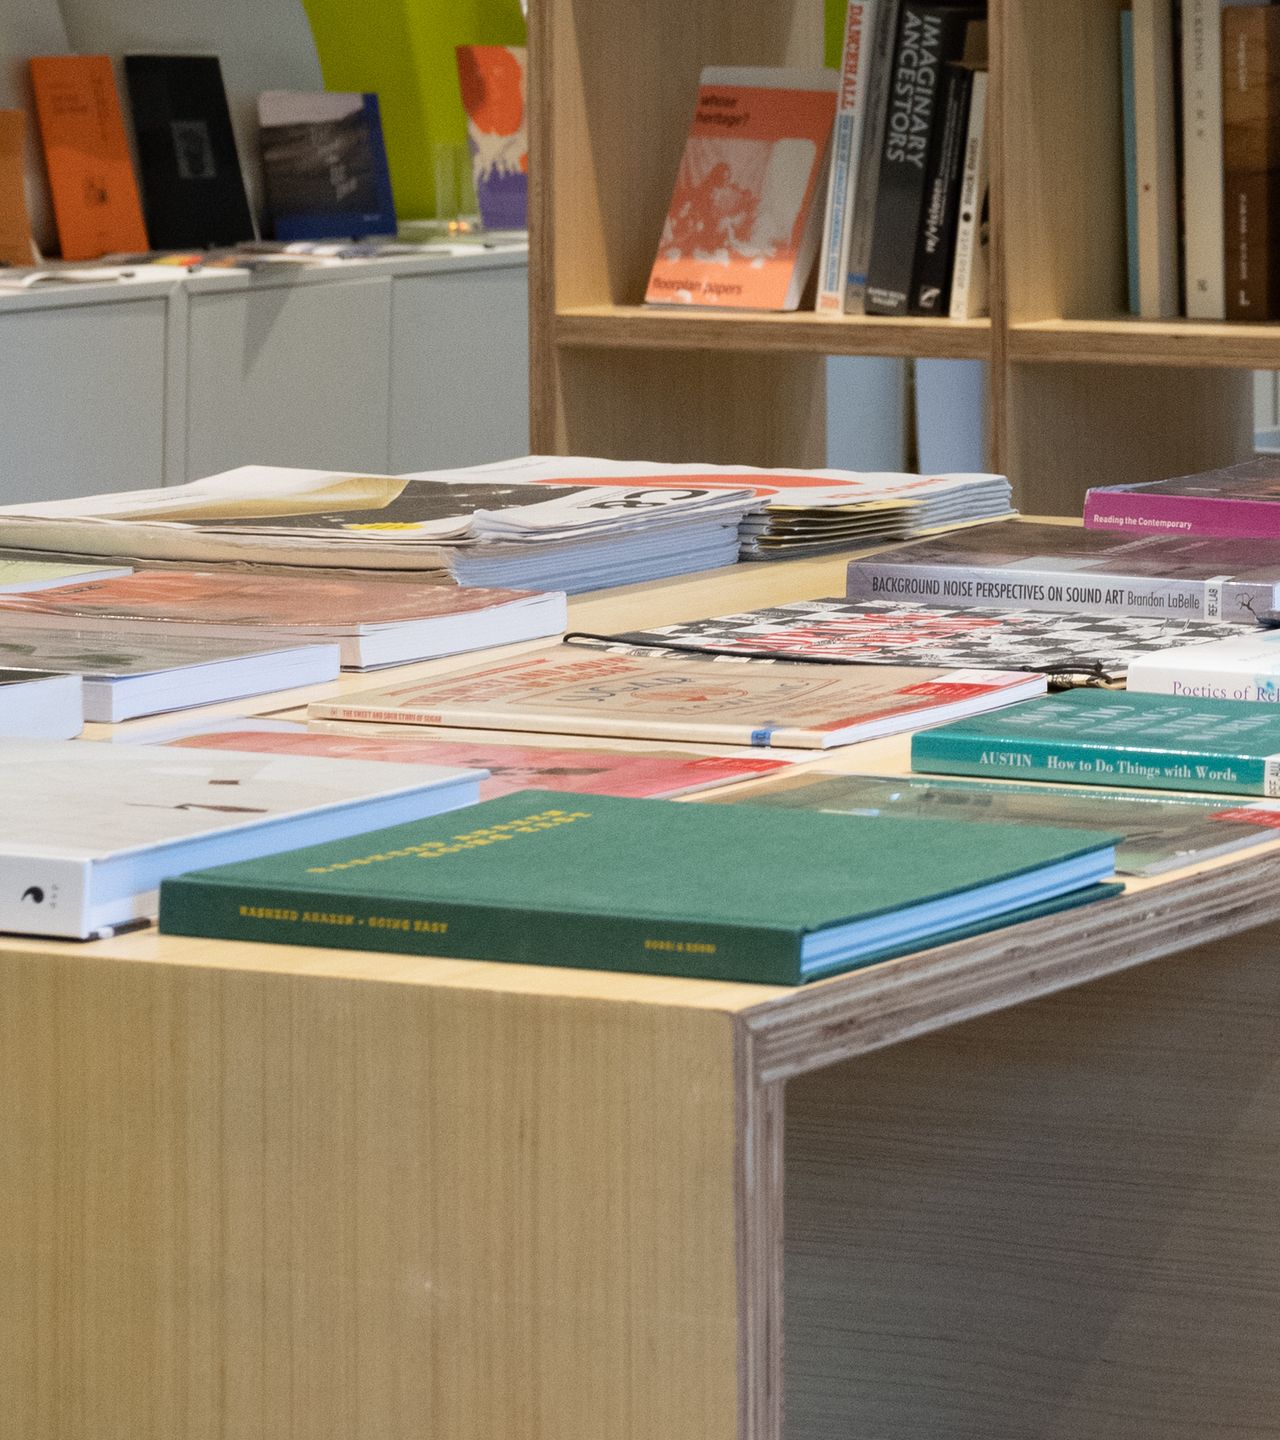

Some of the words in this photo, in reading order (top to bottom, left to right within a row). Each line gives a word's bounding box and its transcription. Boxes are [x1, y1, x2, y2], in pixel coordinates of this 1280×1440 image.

[884, 9, 923, 163] ANCESTORS
[905, 14, 943, 170] IMAGINARY
[1092, 513, 1125, 526] Reading
[1124, 515, 1137, 525] the
[1137, 516, 1192, 531] Contemporary
[871, 576, 940, 596] BACKGROUND
[942, 580, 974, 597] NOISE
[975, 581, 1045, 601] PERSPECTIVES
[1047, 585, 1063, 602] ON
[1065, 586, 1103, 604] SOUND
[1104, 588, 1124, 605] ART
[1126, 590, 1165, 608] Brandon
[1167, 592, 1201, 610] LaBelle
[1171, 680, 1228, 699] Poetics
[1232, 684, 1251, 701] of
[978, 750, 1032, 768] AUSTIN
[1046, 755, 1076, 771] How
[1078, 757, 1092, 772] to
[1094, 757, 1114, 773] Do
[1115, 759, 1161, 780] Things
[1163, 763, 1191, 779] with
[1194, 765, 1237, 782] Words
